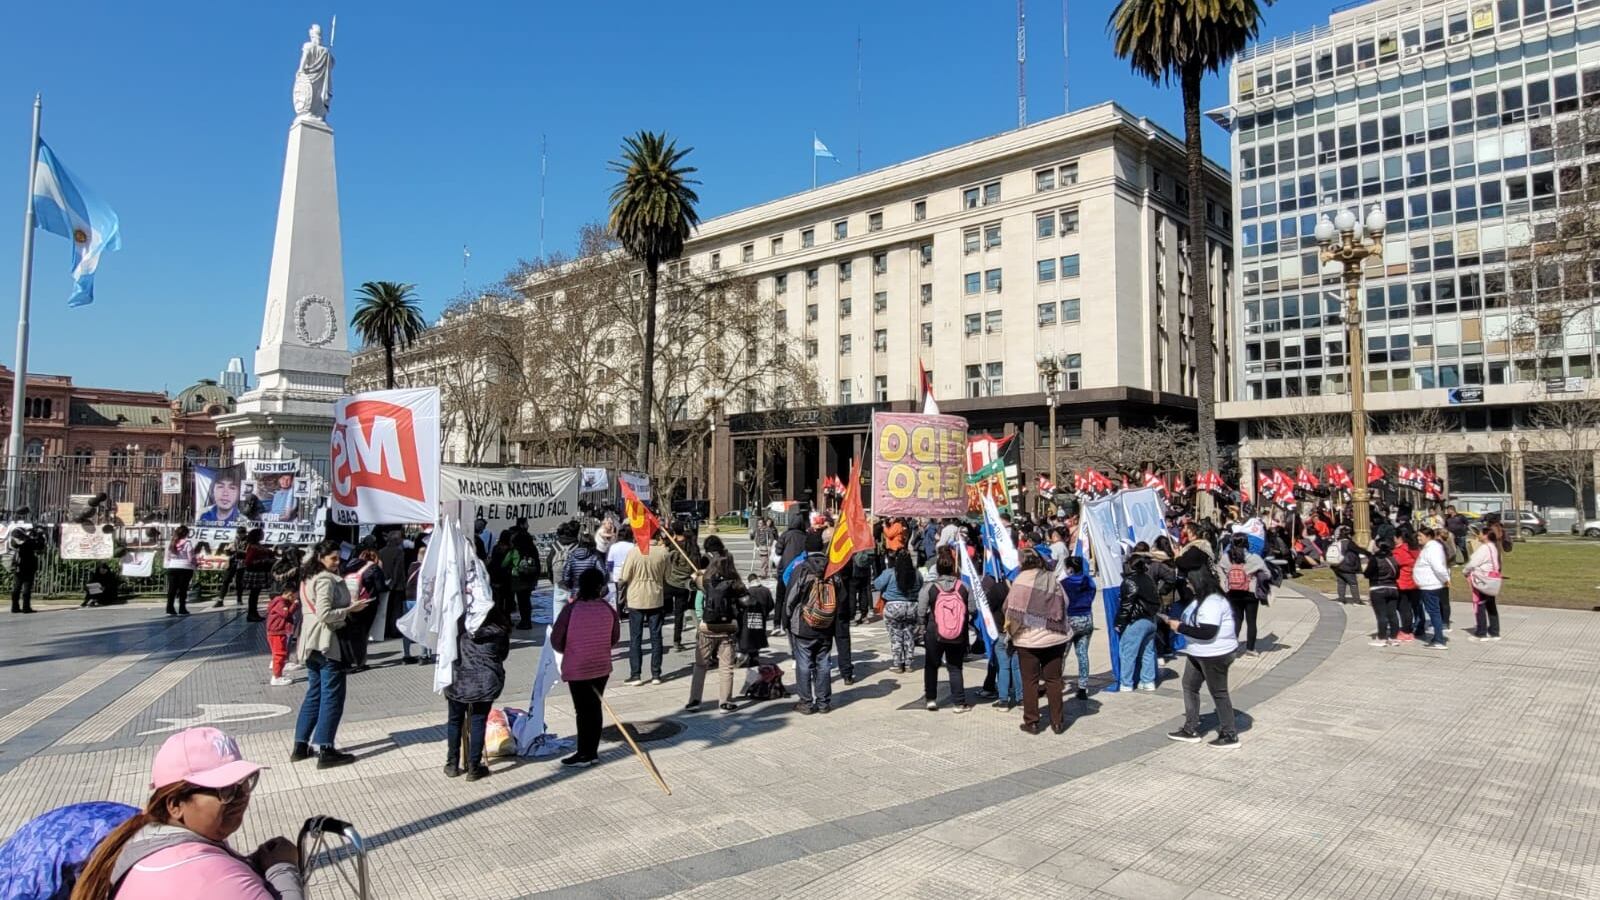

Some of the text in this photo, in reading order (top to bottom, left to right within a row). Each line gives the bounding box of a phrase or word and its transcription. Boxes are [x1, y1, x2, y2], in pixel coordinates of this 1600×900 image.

[254, 462, 297, 472] JUSTICIA
[458, 479, 555, 497] MARCHA NACIONAL
[488, 504, 500, 519] EL
[506, 502, 545, 519] GATILLO
[547, 500, 569, 517] FACIL
[214, 529, 231, 540] ES
[279, 532, 294, 542] DE
